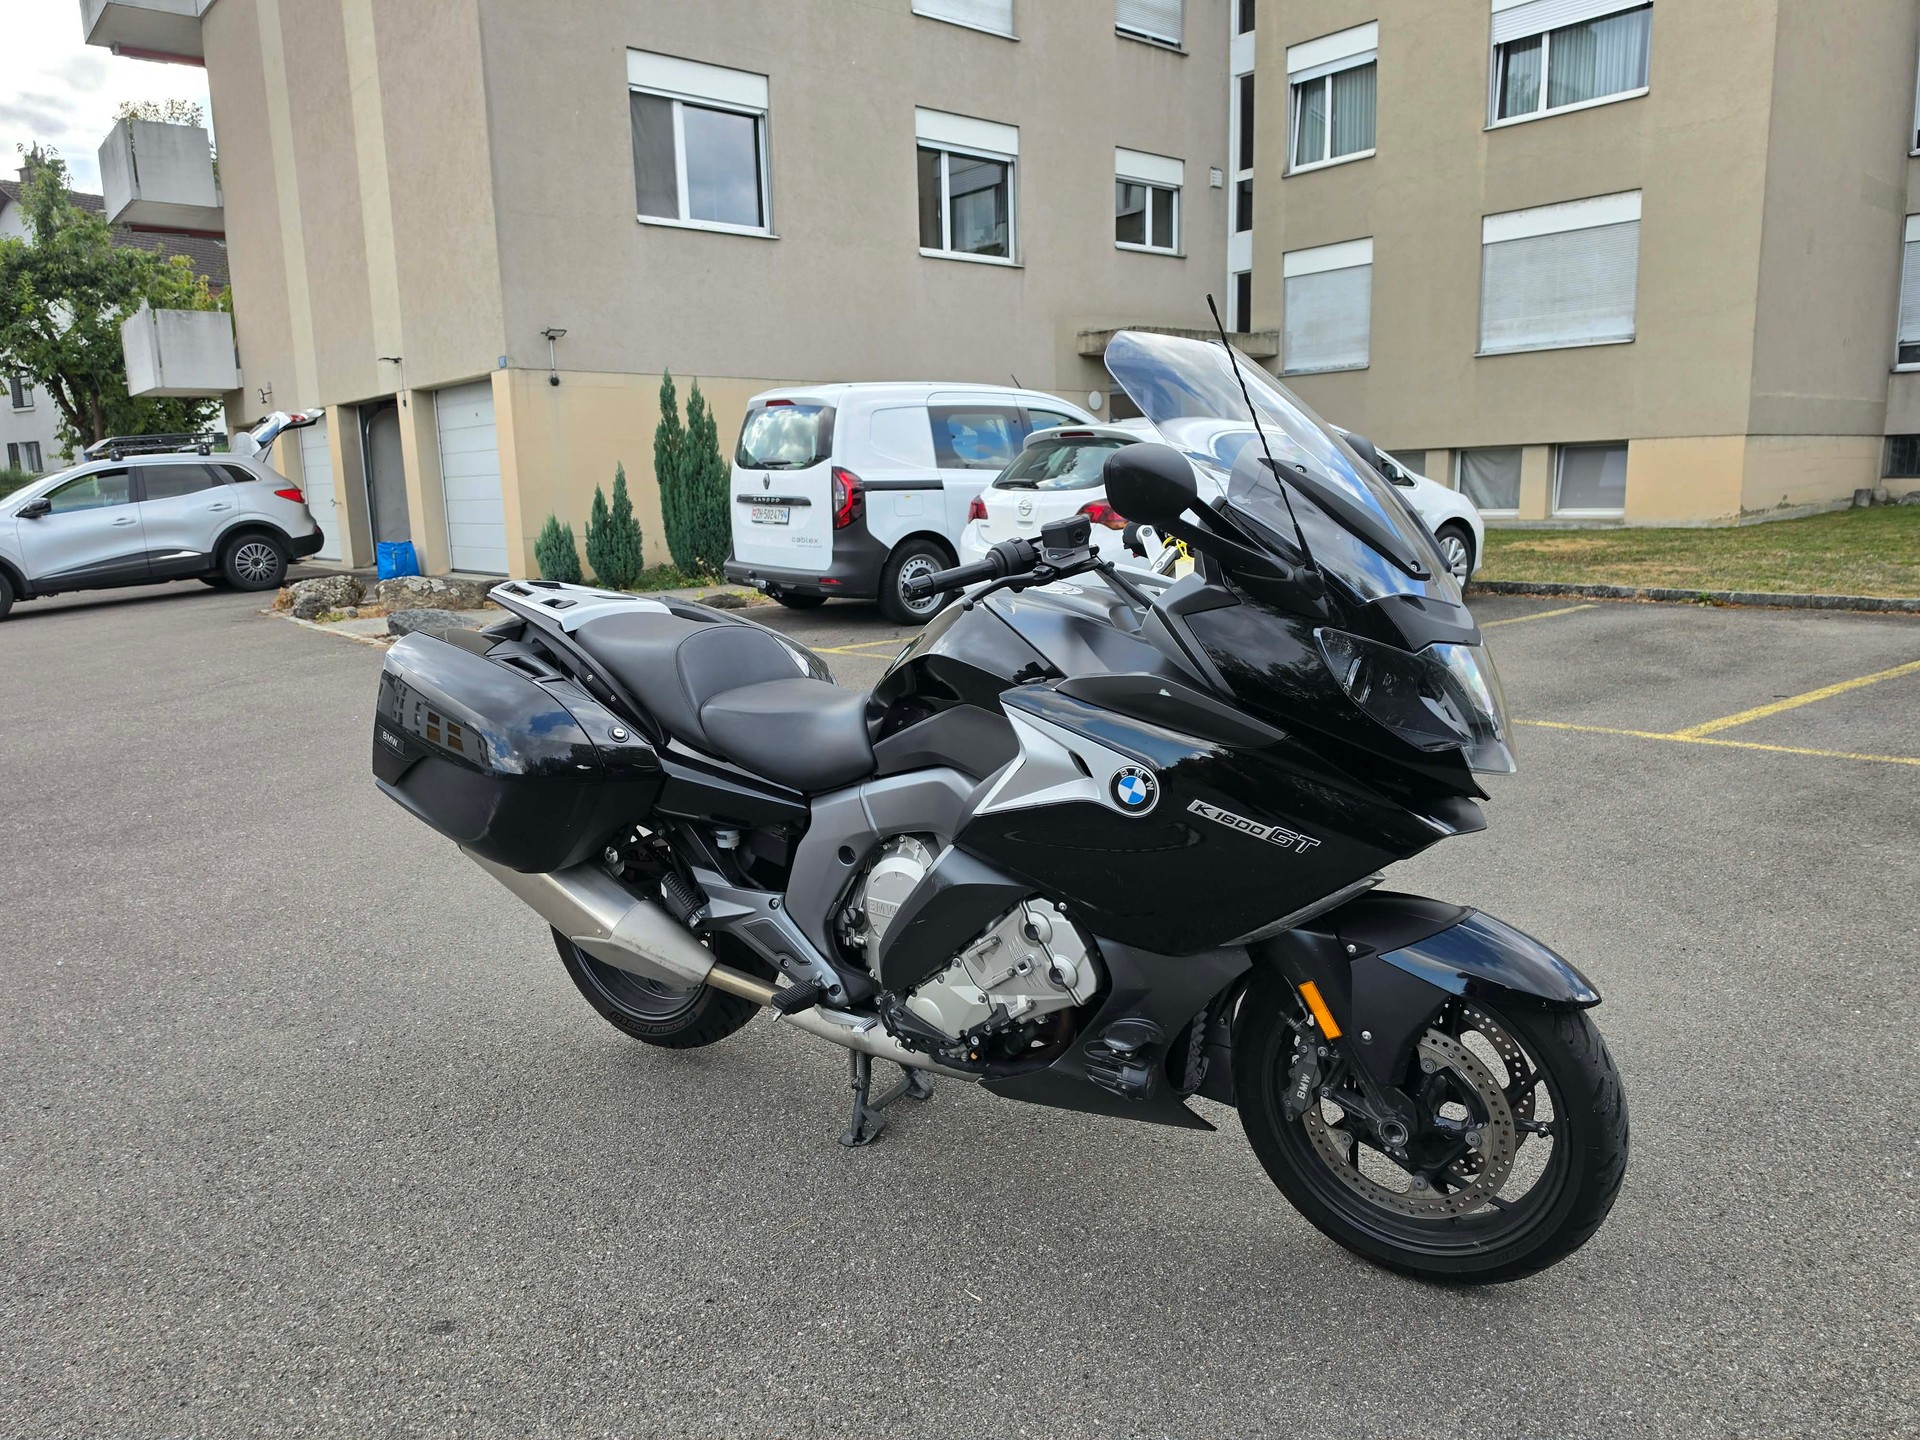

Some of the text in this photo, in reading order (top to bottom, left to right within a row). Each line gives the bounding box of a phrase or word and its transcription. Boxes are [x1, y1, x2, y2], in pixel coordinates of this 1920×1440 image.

[791, 536, 819, 544] cablex
[382, 731, 398, 747] BMW
[1119, 768, 1155, 792] BMW
[870, 901, 899, 916] BMW
[627, 1020, 647, 1033] ROAD
[651, 1020, 687, 1033] MICHELIN
[1296, 1072, 1311, 1100] BMW
